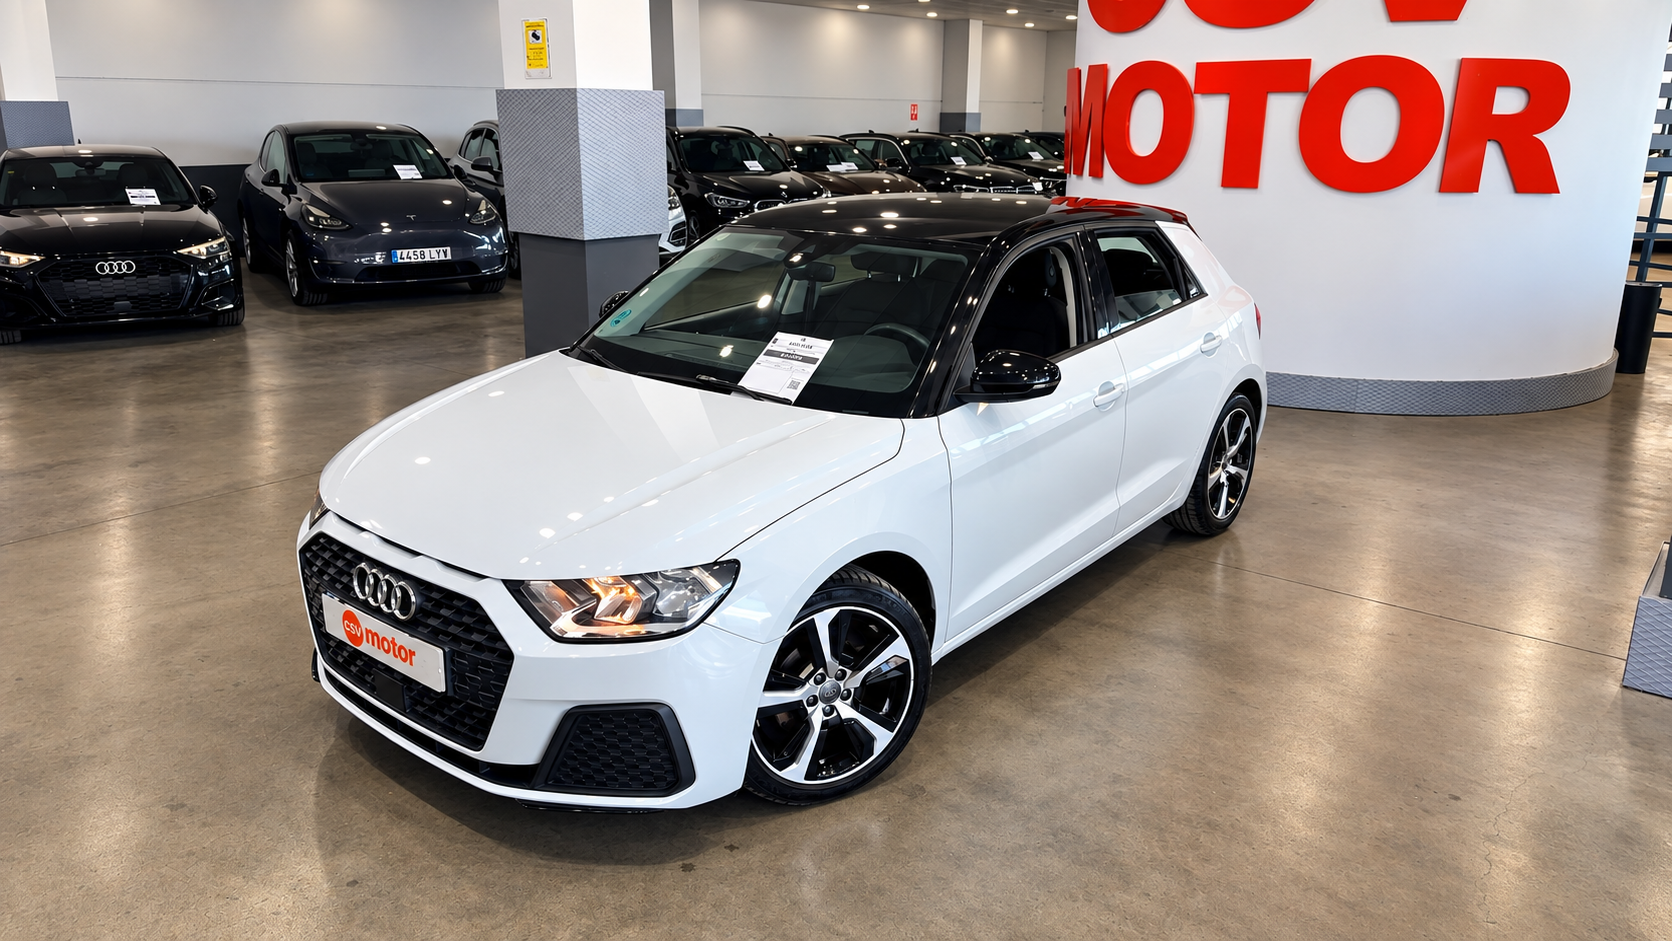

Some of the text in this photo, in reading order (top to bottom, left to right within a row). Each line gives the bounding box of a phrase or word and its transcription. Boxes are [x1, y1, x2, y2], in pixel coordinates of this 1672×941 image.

[1064, 55, 1570, 194] MOTOR
[399, 250, 426, 261] 4458
[343, 620, 416, 667] CSV motor
